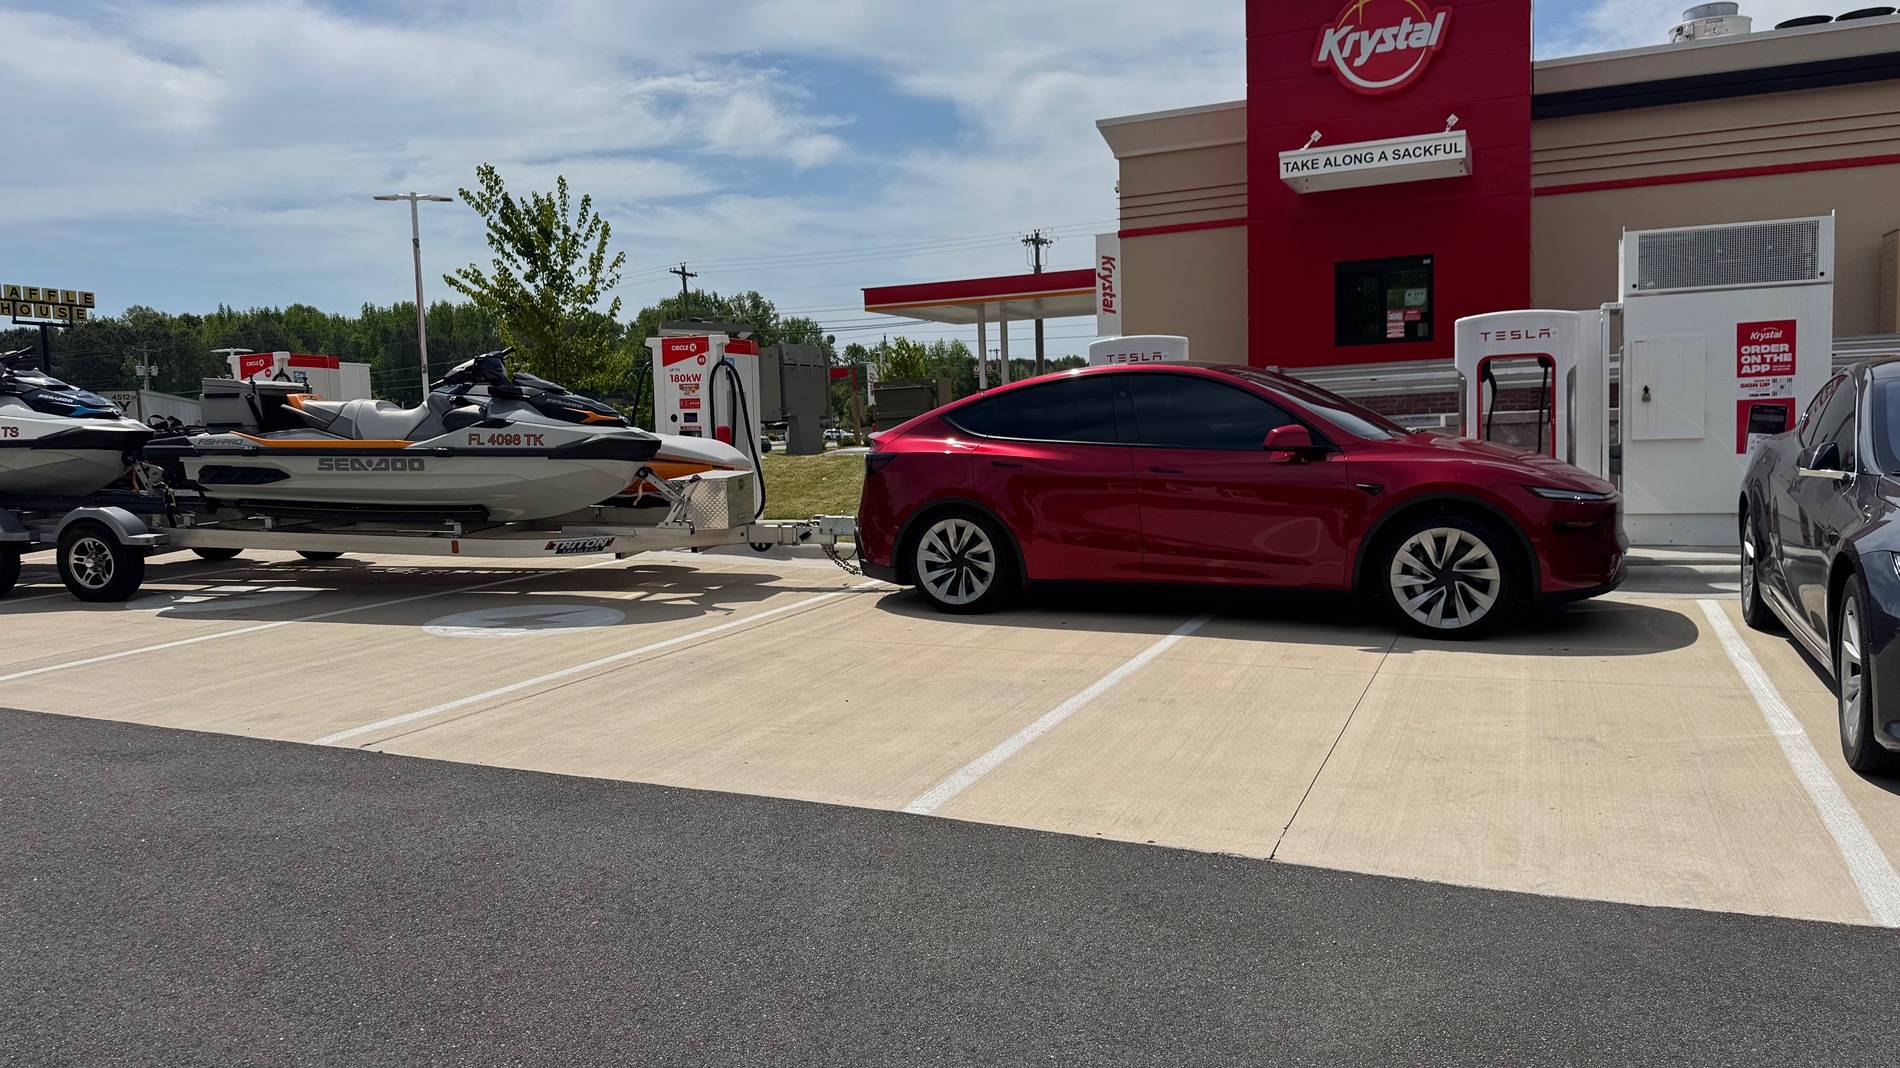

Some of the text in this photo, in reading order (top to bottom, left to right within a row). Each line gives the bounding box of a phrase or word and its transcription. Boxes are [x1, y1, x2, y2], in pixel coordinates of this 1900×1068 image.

[1317, 12, 1447, 67] Krystal
[1283, 142, 1463, 173] TAKE ALONG A SACKFUL
[1098, 255, 1116, 315] Krystal
[9, 287, 93, 305] AFFLE
[1, 302, 85, 320] HOUSE
[1480, 328, 1550, 342] TESLA
[1750, 330, 1783, 342] Krystal
[1740, 343, 1789, 354] ORDER
[1106, 352, 1162, 363] TESLA
[1740, 353, 1792, 364] ON THE
[1741, 364, 1771, 374] APP
[670, 374, 702, 382] 180kW
[1, 426, 19, 438] TS
[468, 433, 485, 446] FL
[524, 433, 544, 446] TK
[554, 537, 609, 549] TRITON
